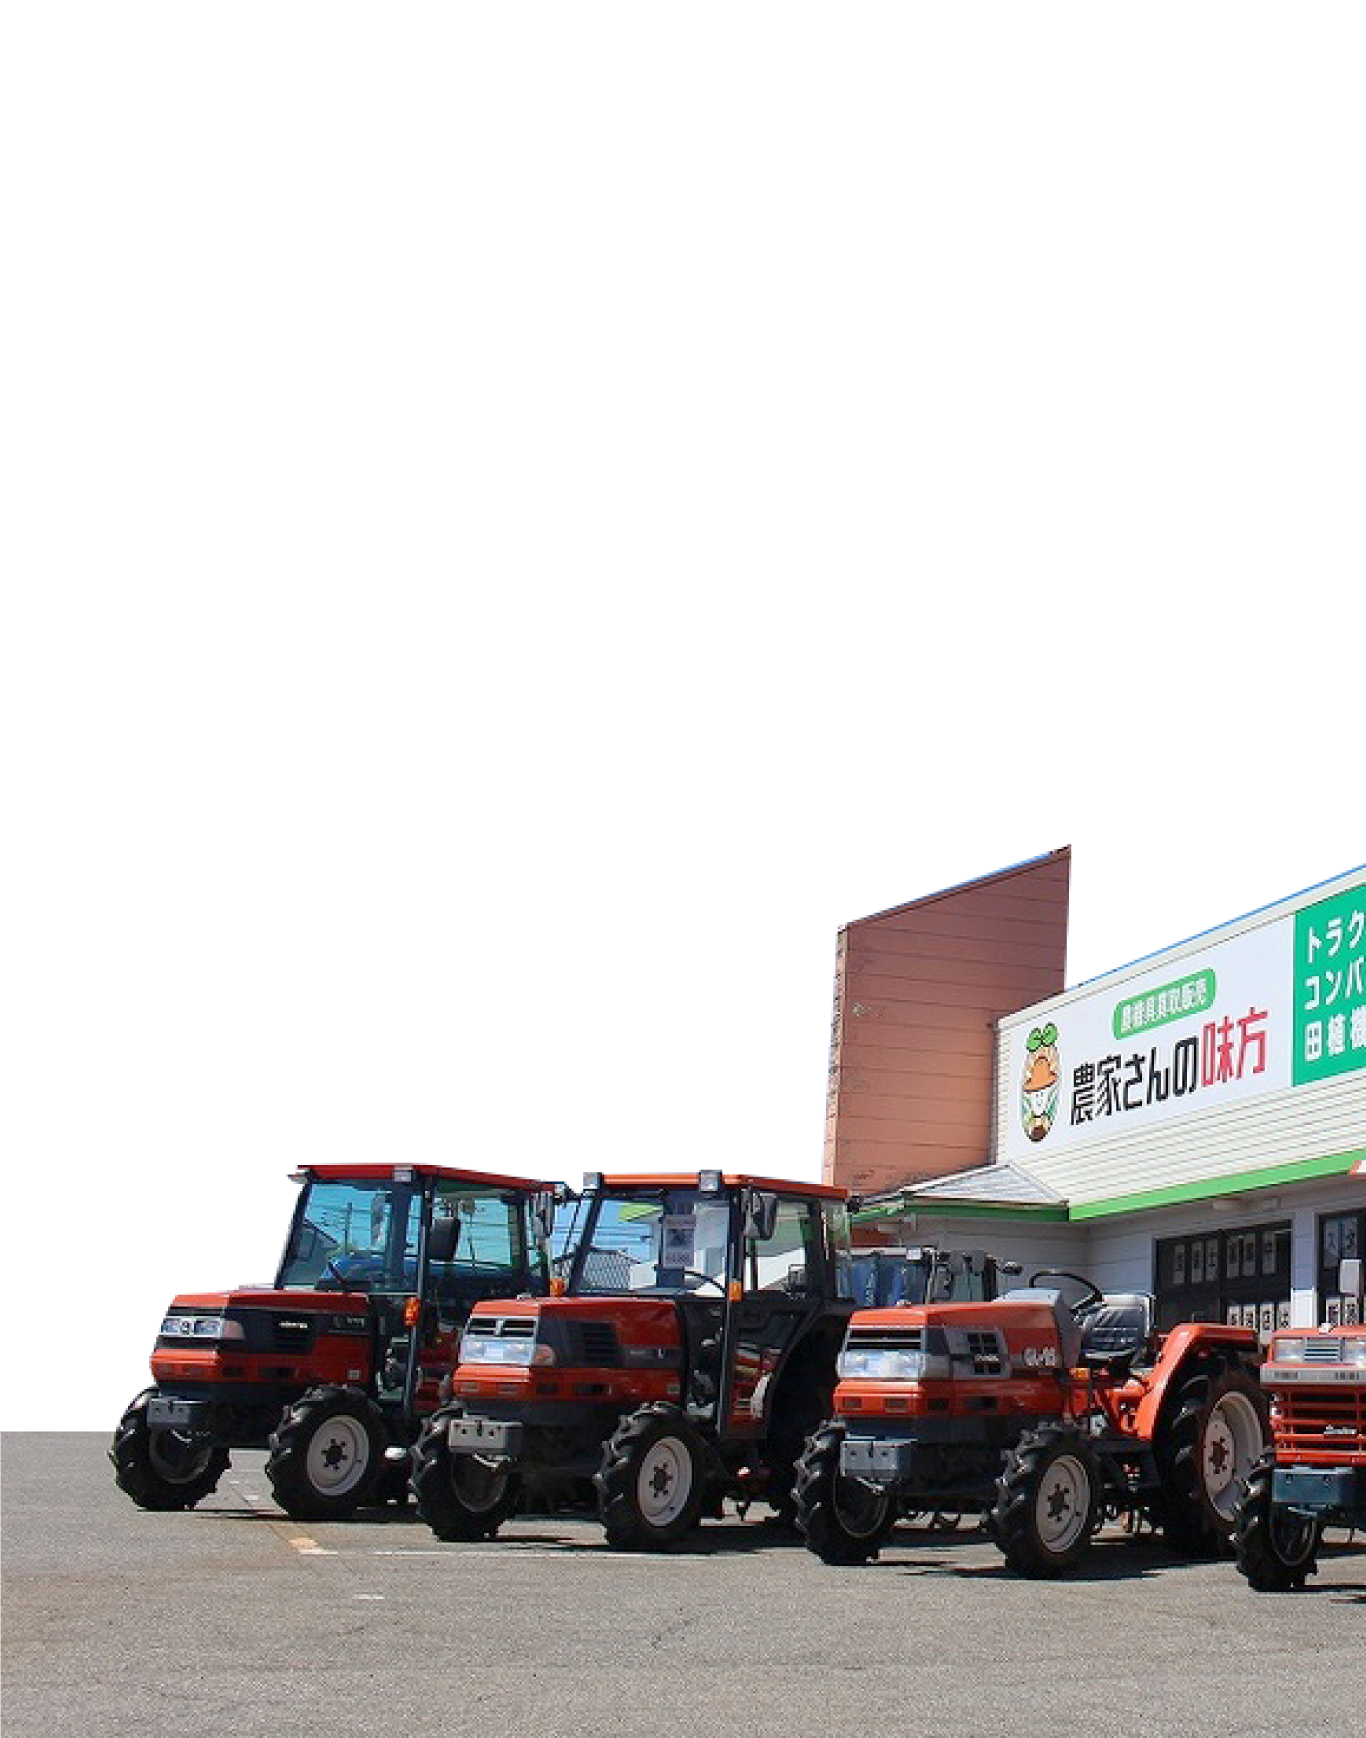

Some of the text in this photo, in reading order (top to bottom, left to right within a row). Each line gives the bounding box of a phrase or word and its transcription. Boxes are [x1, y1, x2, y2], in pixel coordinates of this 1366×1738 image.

[1070, 1006, 1270, 1126] 農家さんの味方
